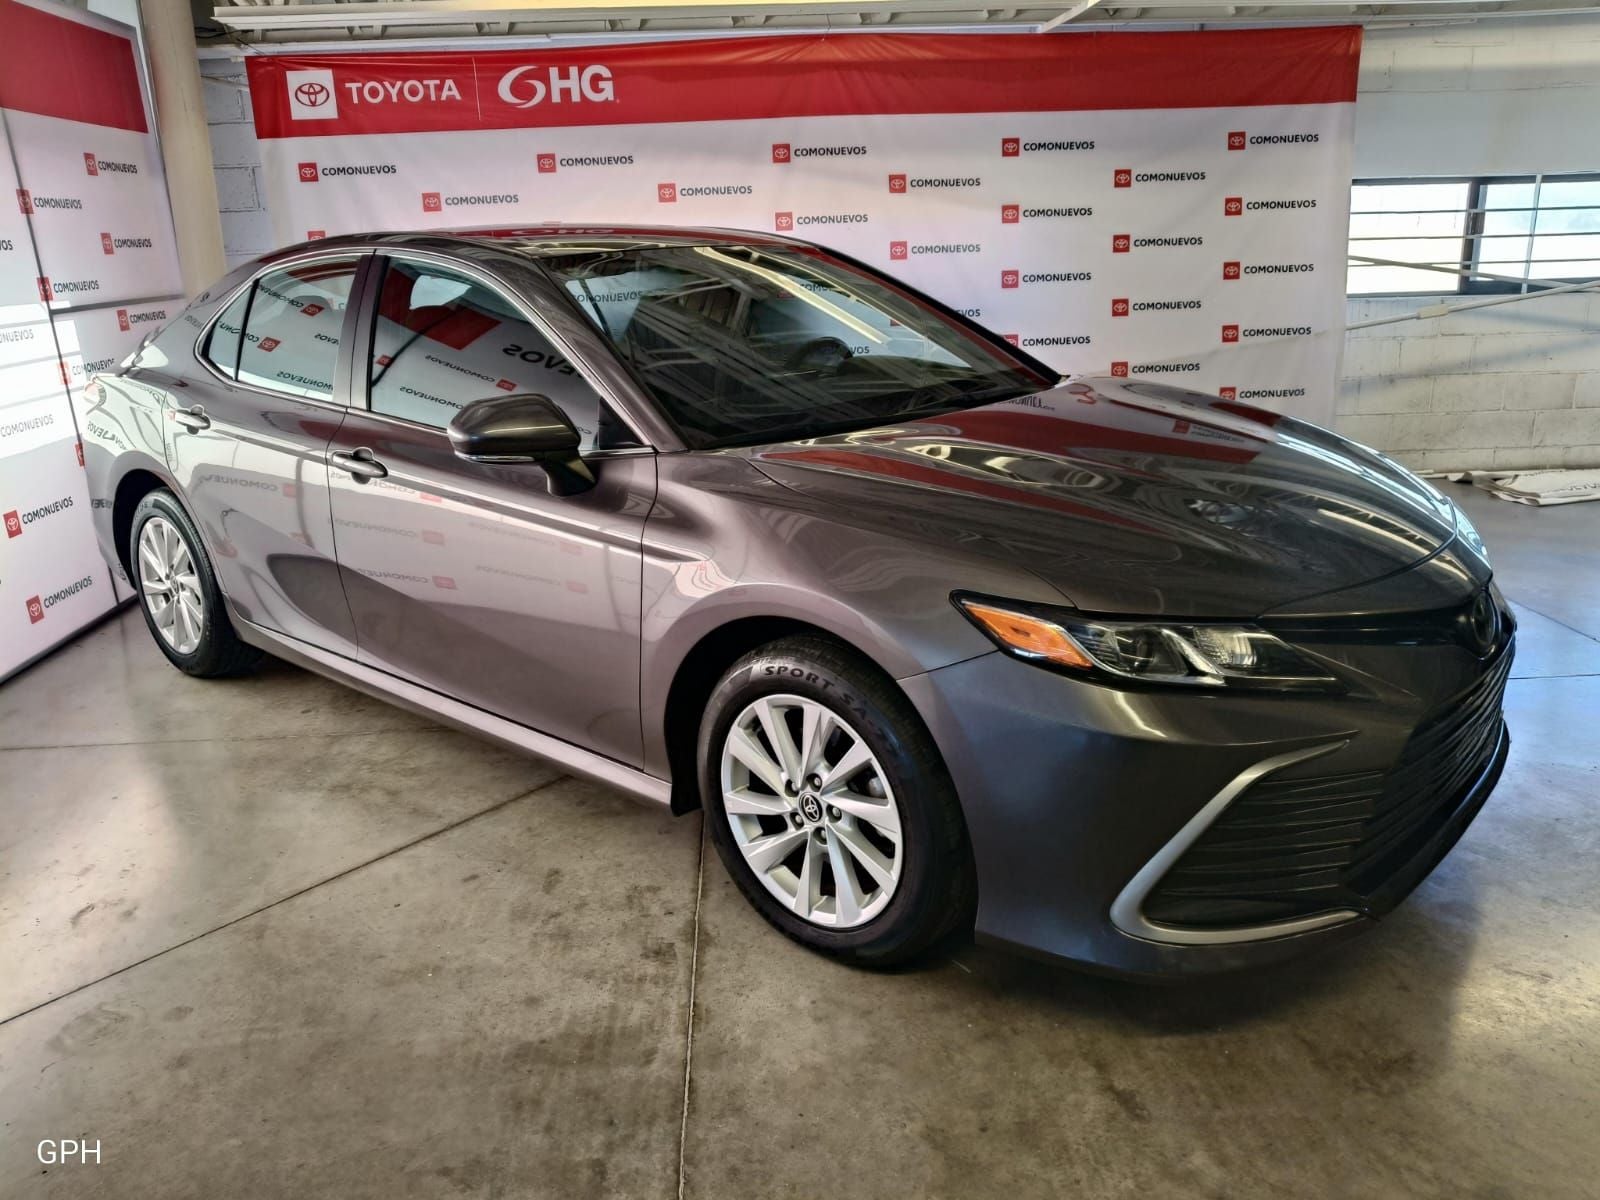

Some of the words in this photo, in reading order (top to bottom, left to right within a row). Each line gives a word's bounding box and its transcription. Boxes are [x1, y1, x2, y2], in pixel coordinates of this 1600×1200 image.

[345, 78, 461, 105] TOYOTA
[1249, 133, 1319, 145] COMONUEVOS
[794, 146, 867, 158] COMONUEVOS
[1023, 140, 1095, 152] COMONUEVOS
[98, 160, 138, 174] COMONUEVOS
[560, 155, 634, 167] COMONUEVOS
[322, 164, 397, 177] COMONUEVOS
[910, 177, 981, 188] COMONUEVOS
[1135, 171, 1206, 183] COMONUEVOS
[680, 185, 753, 197] COMONUEVOS
[34, 197, 82, 209] COMONUEVOS
[445, 193, 519, 206] COMONUEVOS
[1246, 199, 1317, 211] COMONUEVOS
[1022, 207, 1092, 218] COMONUEVOS
[797, 213, 868, 225] COMONUEVOS
[114, 238, 152, 249] COMONUEVOS
[1134, 236, 1203, 248] COMONUEVOS
[911, 243, 981, 255] COMONUEVOS
[1244, 263, 1314, 275] COMONUEVOS
[1022, 272, 1091, 283] COMONUEVOS
[54, 280, 99, 293] COMONUEVOS
[1132, 300, 1202, 311] COMONUEVOS
[130, 310, 167, 324] COMONUEVOS
[1242, 326, 1312, 338] COMONUEVOS
[1022, 336, 1091, 346] COMONUEVOS
[1132, 363, 1201, 374] COMONUEVOS
[1239, 388, 1305, 399] COMONUEVOS
[1, 414, 54, 437] COMONUEVOS
[22, 496, 74, 525] COMONUEVOS
[43, 576, 92, 608] COMONUEVOS
[764, 665, 835, 690] SPORT
